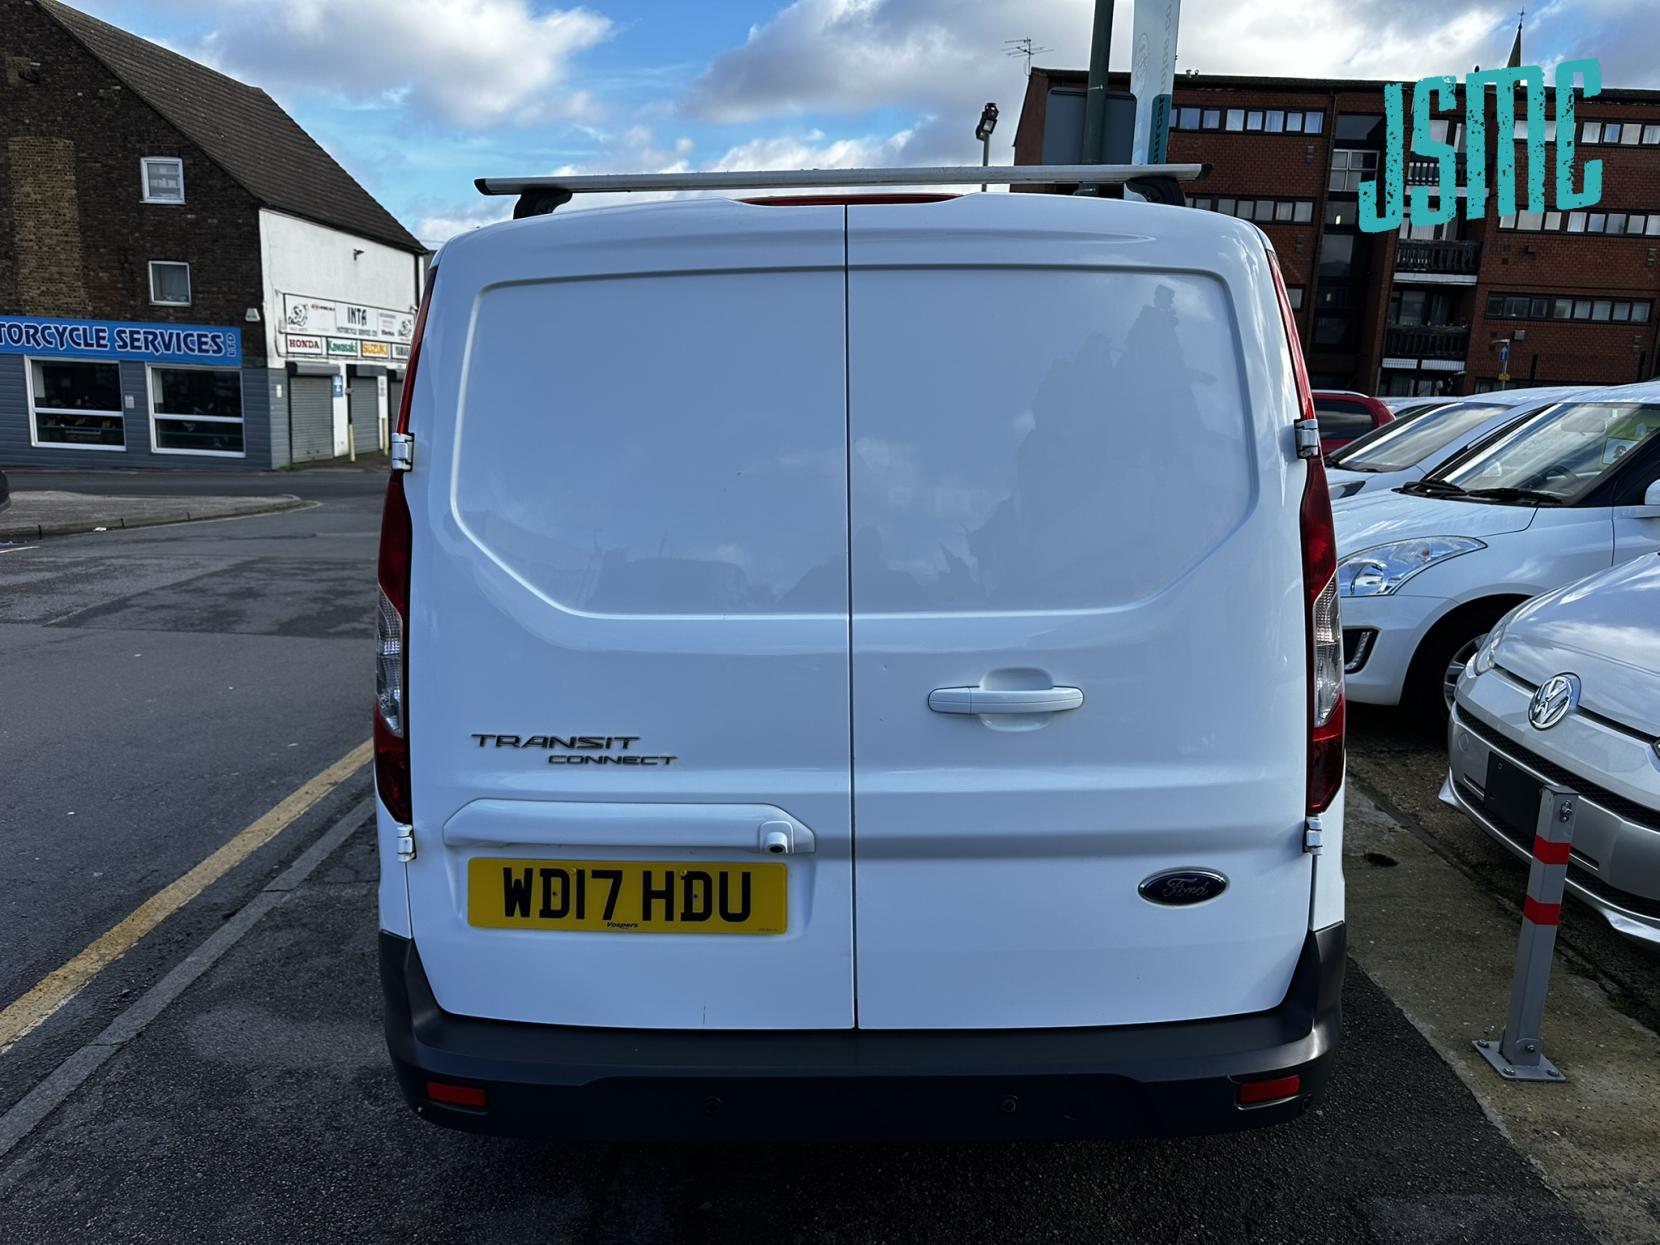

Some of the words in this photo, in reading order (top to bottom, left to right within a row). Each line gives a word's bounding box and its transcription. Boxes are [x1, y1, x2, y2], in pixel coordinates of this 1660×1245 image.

[115, 327, 224, 356] SERVICES
[288, 339, 320, 349] HONDA
[327, 340, 358, 353] Kawasaki
[362, 343, 389, 354] SUZUKI
[471, 733, 640, 750] TRANSIT
[548, 755, 678, 766] CONNECT
[503, 867, 623, 921] WD17
[642, 870, 751, 923] HDU
[1162, 877, 1210, 898] Ford
